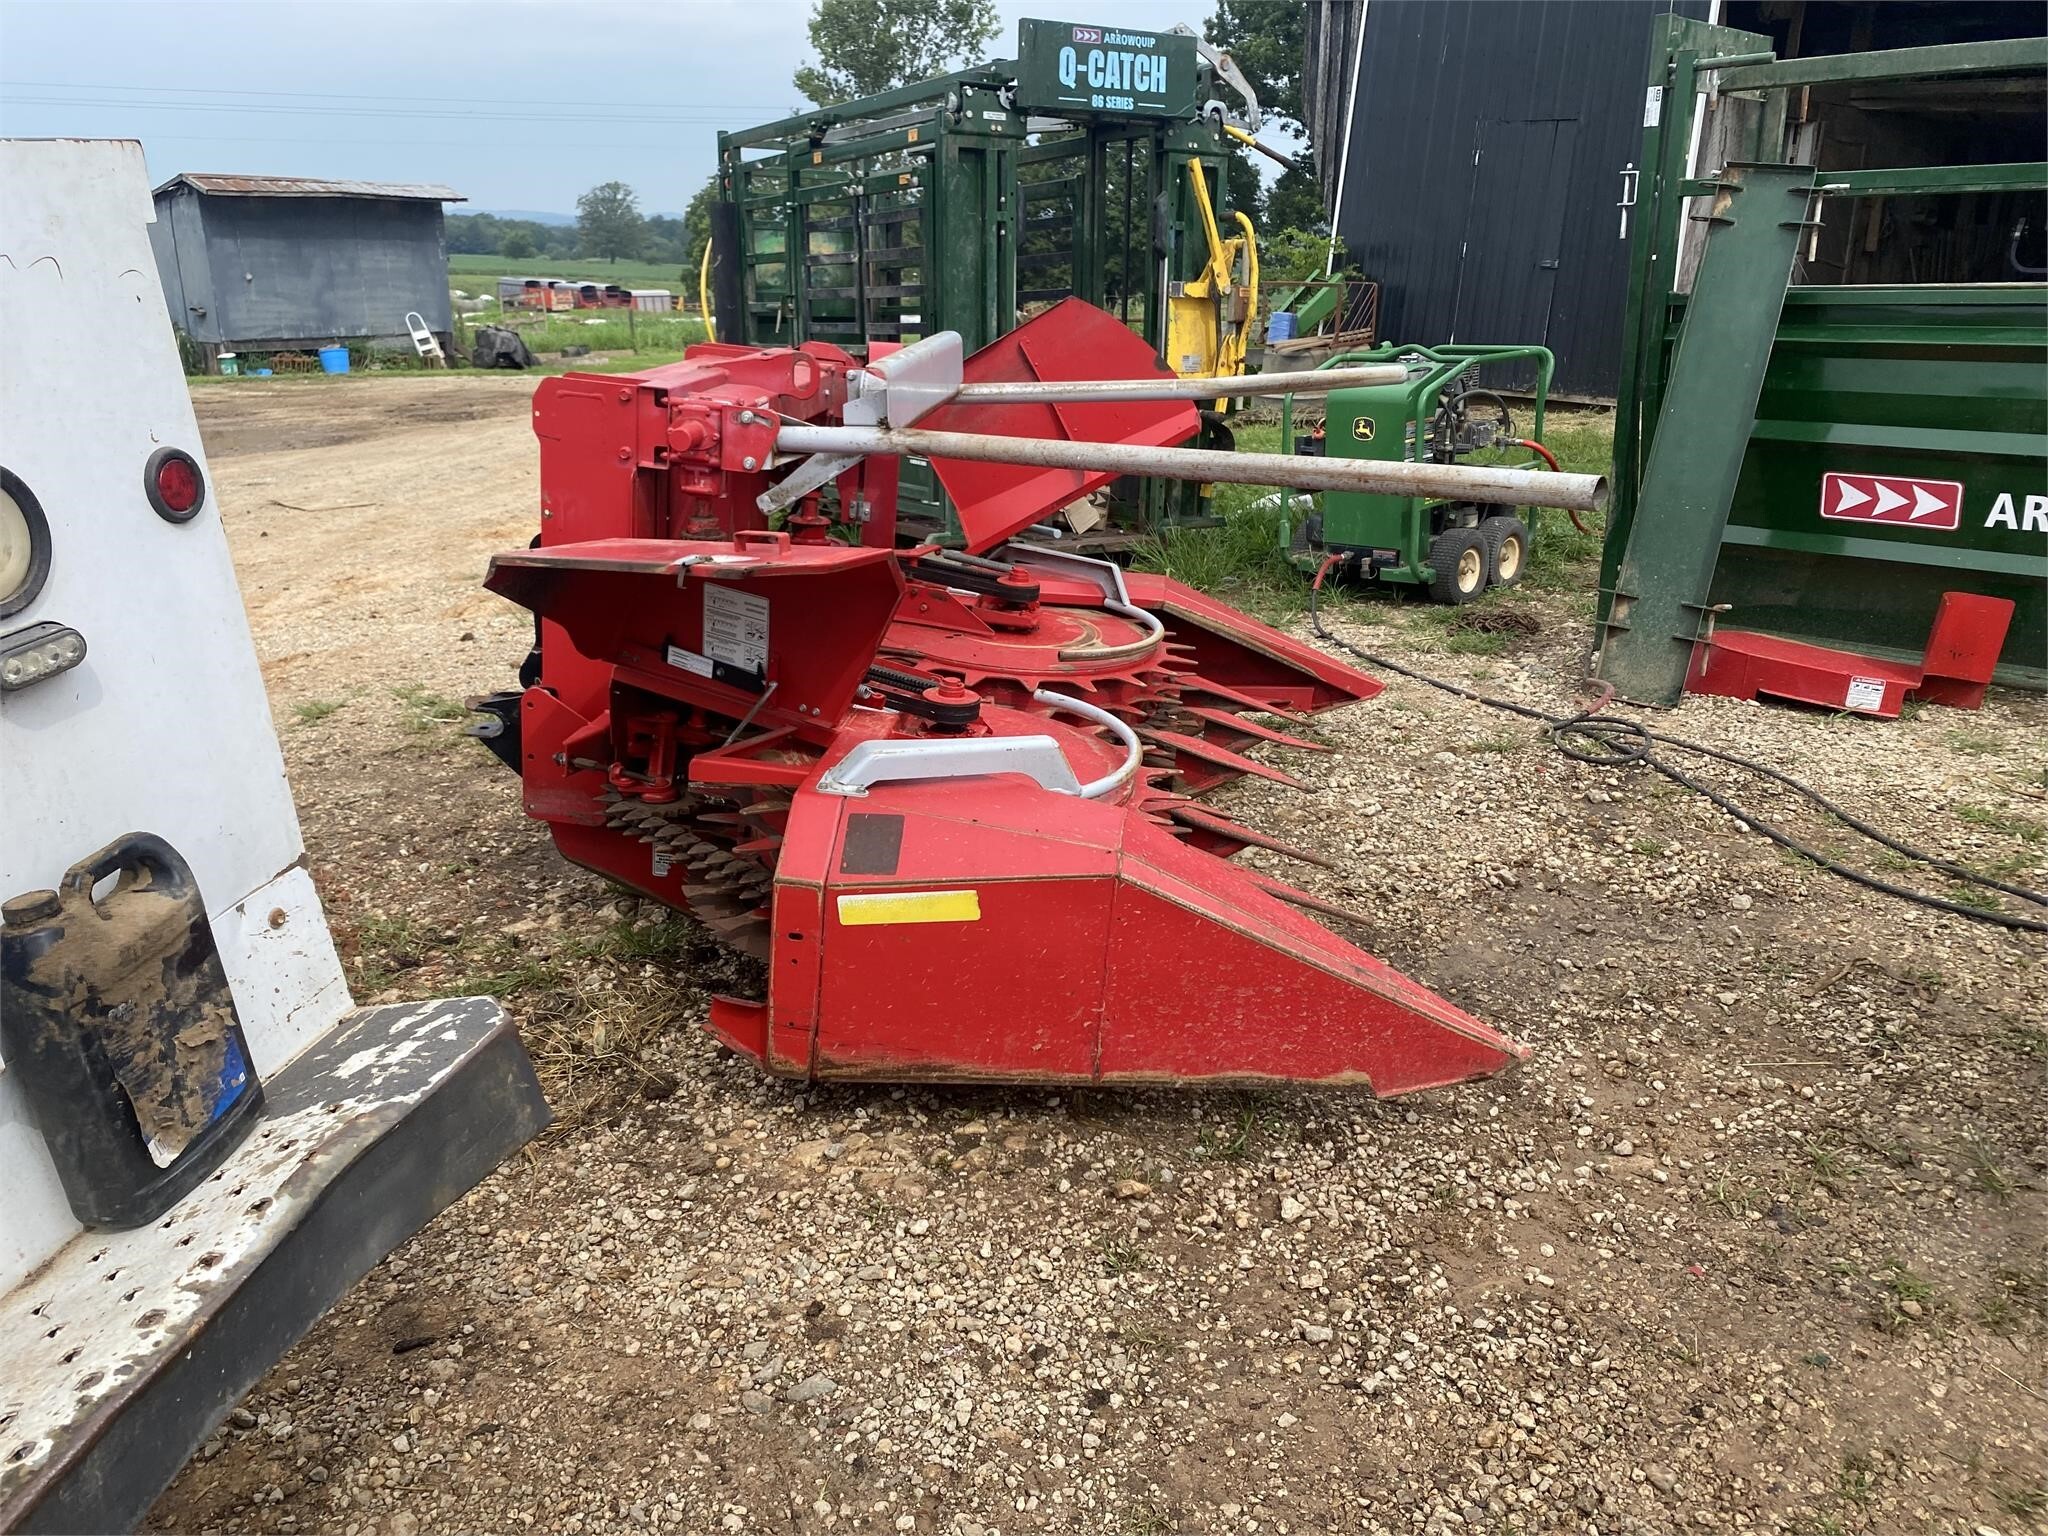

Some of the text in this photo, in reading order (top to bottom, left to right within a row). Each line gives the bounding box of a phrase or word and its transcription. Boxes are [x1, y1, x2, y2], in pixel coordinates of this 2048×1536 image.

[1103, 32, 1156, 49] ARROWQUIP
[1059, 46, 1167, 93] Q-CATCH
[1105, 95, 1134, 110] SERIES
[1983, 492, 2048, 533] AR
